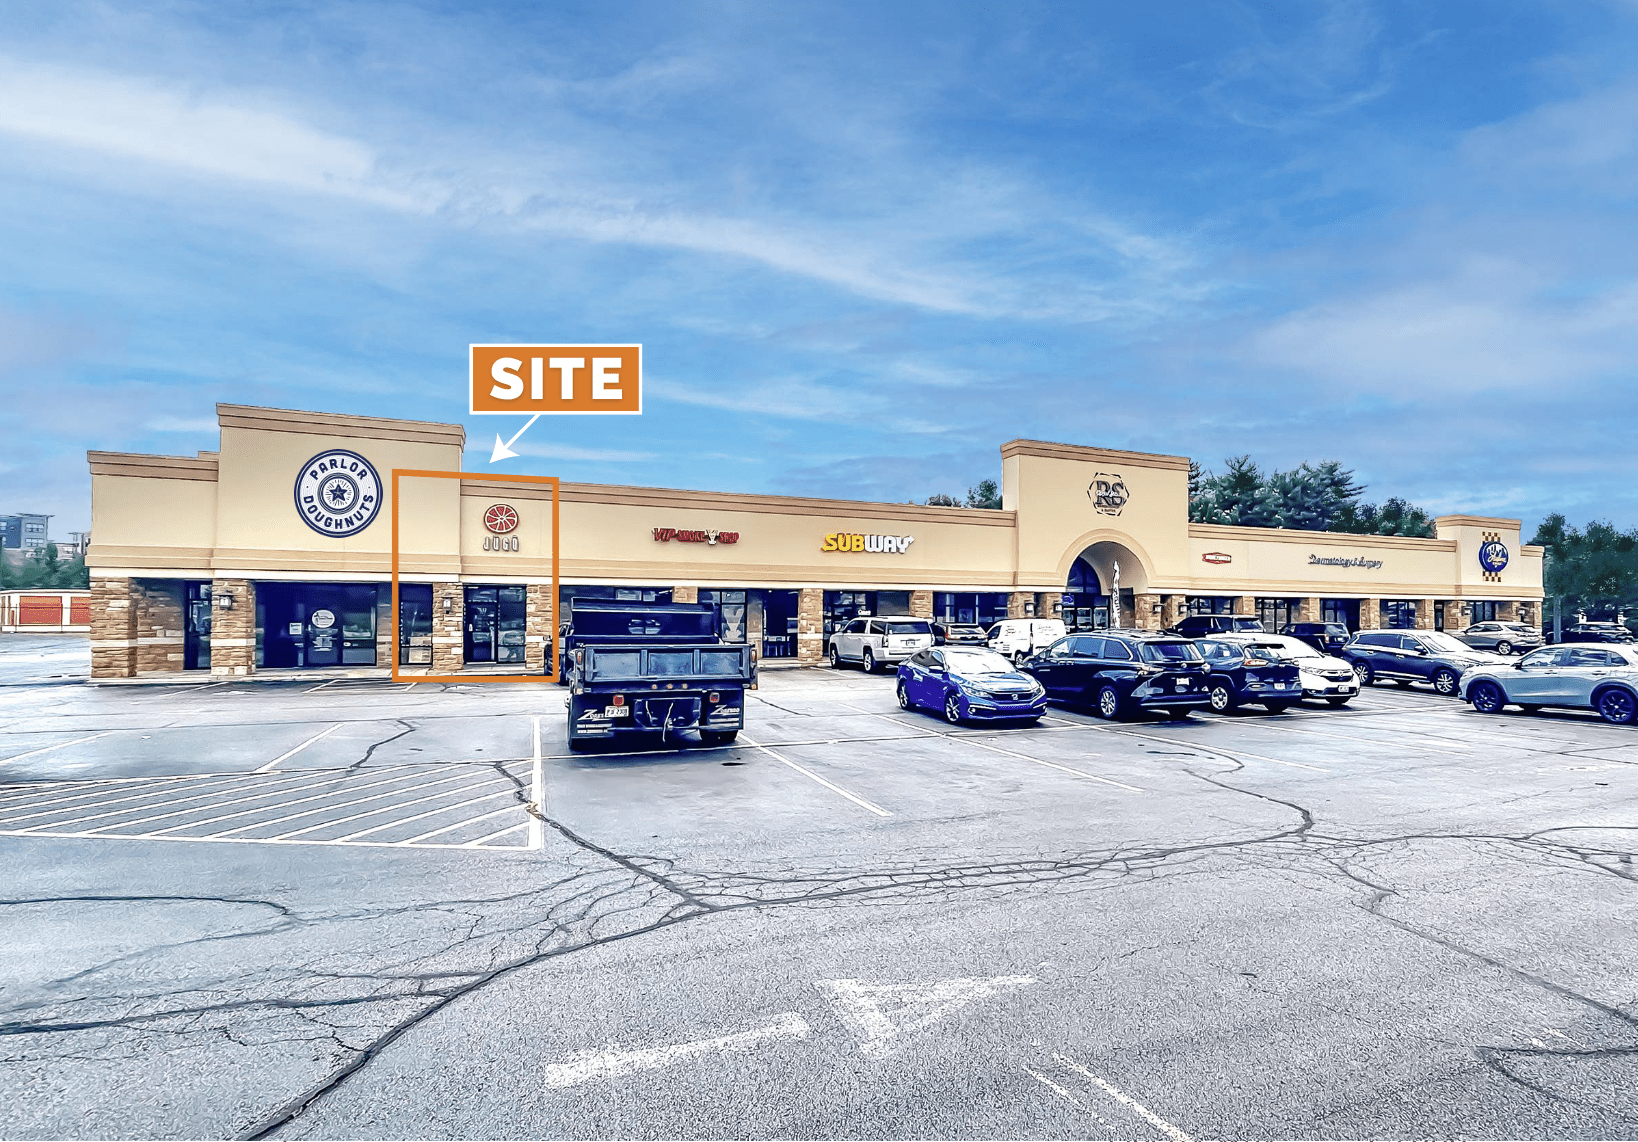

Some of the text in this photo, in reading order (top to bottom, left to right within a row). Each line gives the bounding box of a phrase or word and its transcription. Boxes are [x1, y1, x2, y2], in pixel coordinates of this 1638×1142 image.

[309, 458, 368, 480] PARLOR
[303, 494, 374, 530] DOUGHNUTS
[821, 533, 915, 554] SUBWAY
